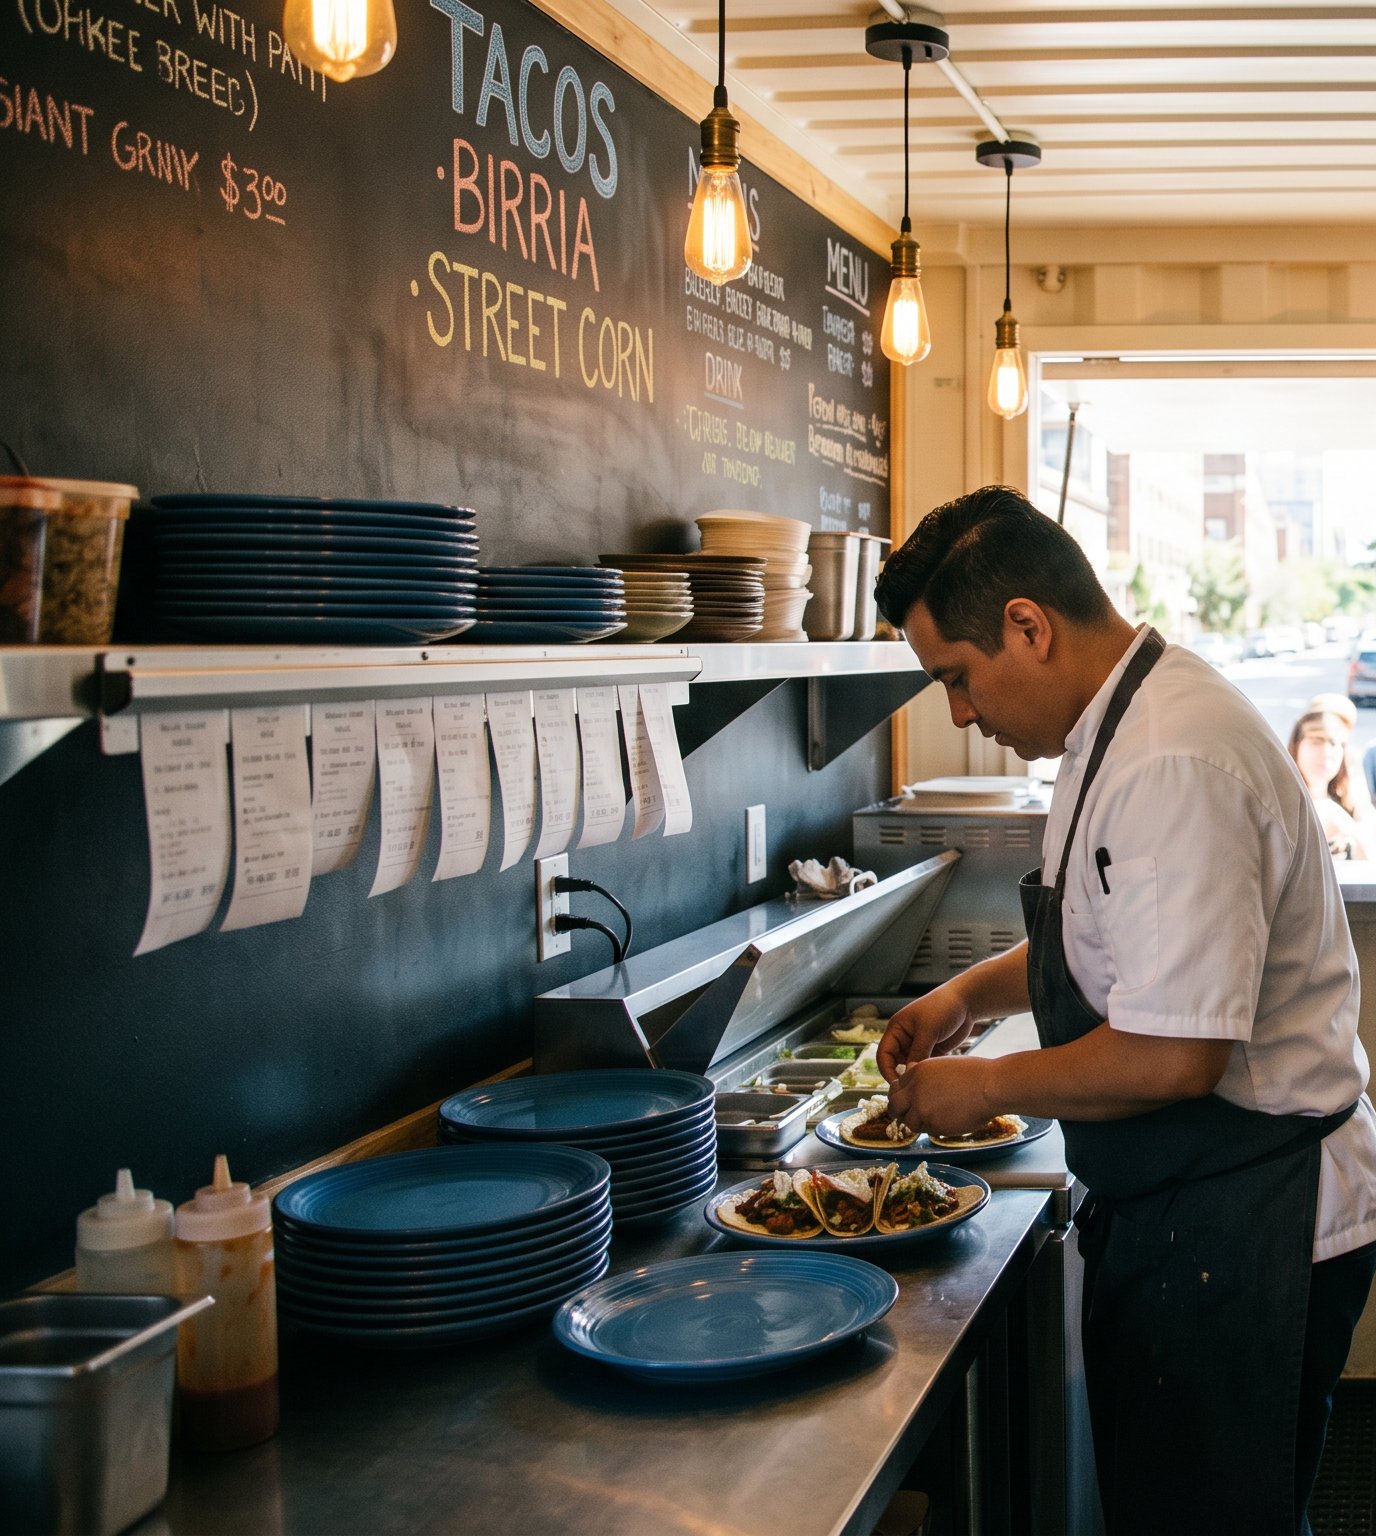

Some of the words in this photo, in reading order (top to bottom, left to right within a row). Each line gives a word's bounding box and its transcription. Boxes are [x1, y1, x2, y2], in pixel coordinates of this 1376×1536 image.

[193, 0, 256, 62] WITH
[429, 0, 618, 199] TACOS
[453, 137, 600, 292] BIRRIA
[426, 250, 567, 379] STREET
[578, 306, 654, 404] CORN
[826, 236, 870, 307] MENU
[704, 351, 743, 401] DRINK
